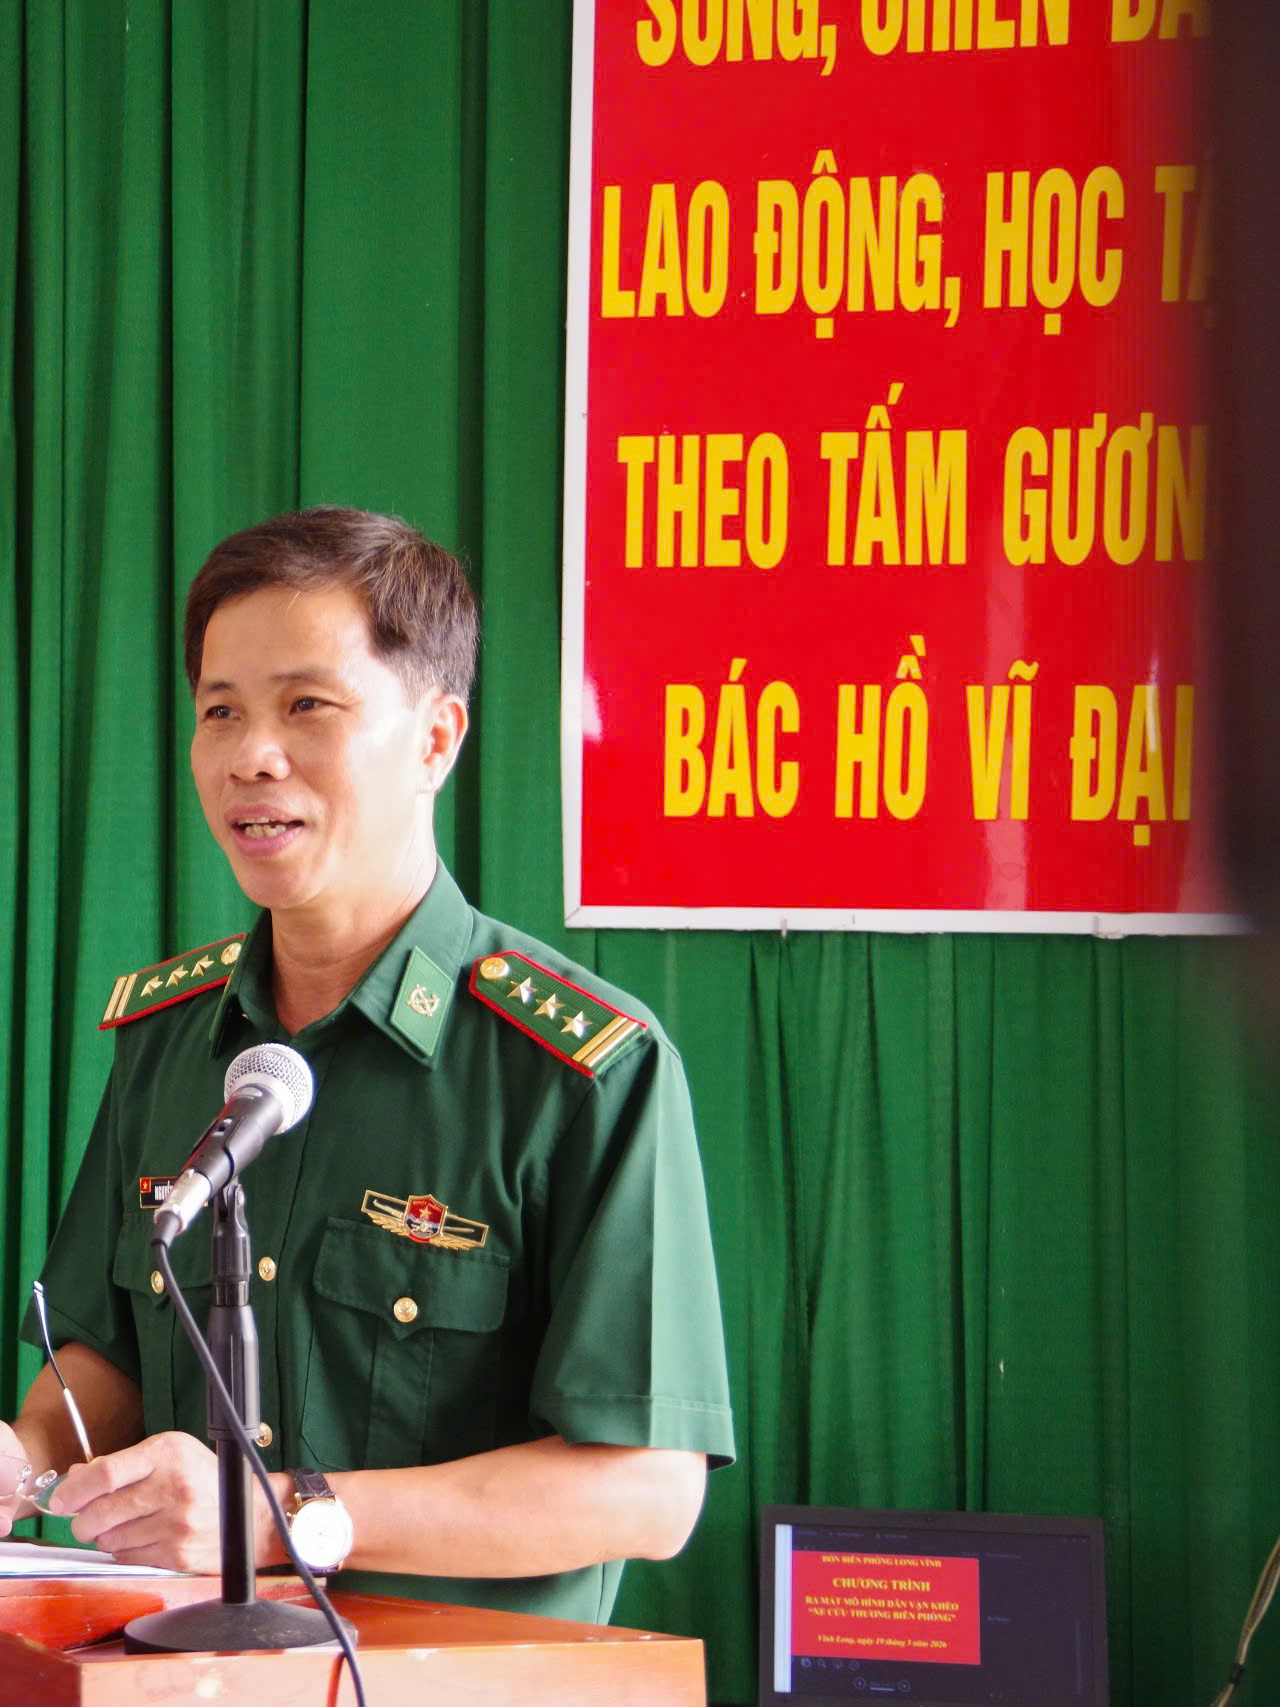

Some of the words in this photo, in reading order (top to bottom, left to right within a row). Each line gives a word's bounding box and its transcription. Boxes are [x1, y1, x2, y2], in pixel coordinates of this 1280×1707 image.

[601, 180, 729, 319] LAO
[754, 150, 961, 339] ĐỘNG,
[984, 166, 1125, 336] HỌC
[617, 432, 789, 570] THEO
[820, 383, 968, 567] TẤM
[663, 658, 801, 820] BÁC
[835, 635, 930, 821] HỒ
[966, 661, 1041, 822] VĨ
[1070, 684, 1196, 848] ĐẠI
[832, 1577, 888, 1590] CHƯƠNG
[890, 1578, 931, 1592] TRÌNH
